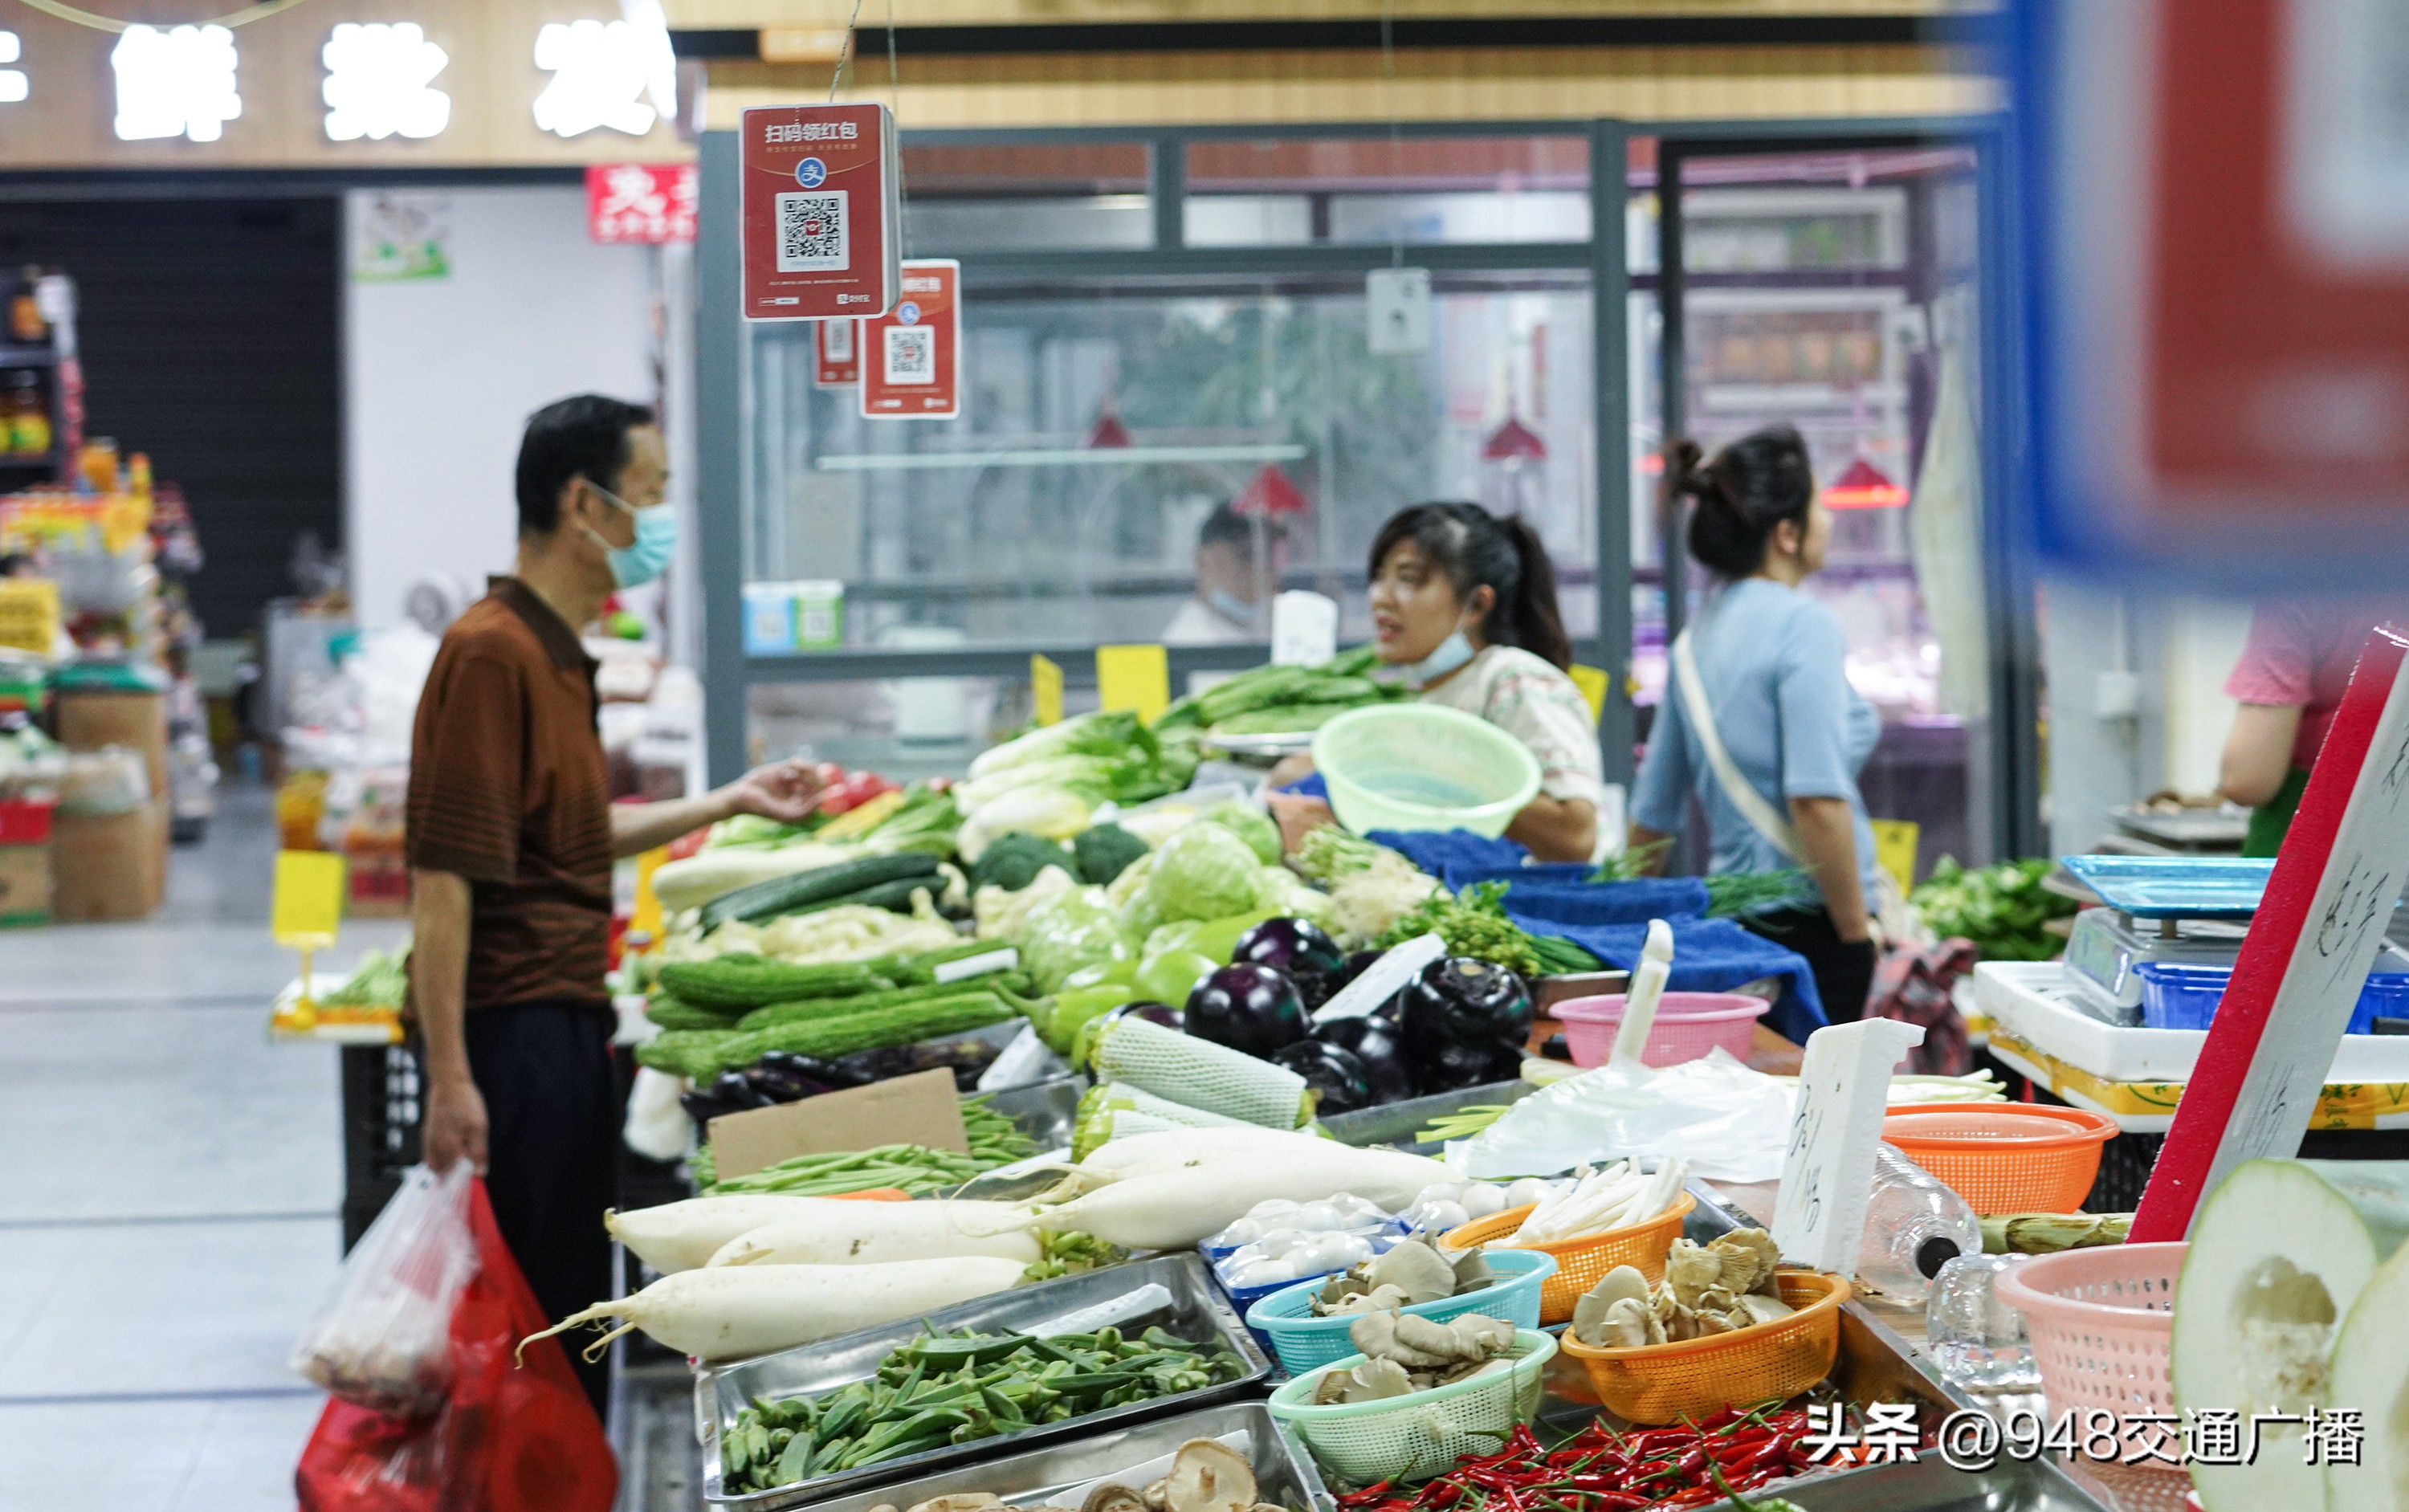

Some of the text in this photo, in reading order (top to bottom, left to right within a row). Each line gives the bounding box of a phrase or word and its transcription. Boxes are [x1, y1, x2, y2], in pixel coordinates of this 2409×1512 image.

[764, 121, 858, 143] 扫码领红包
